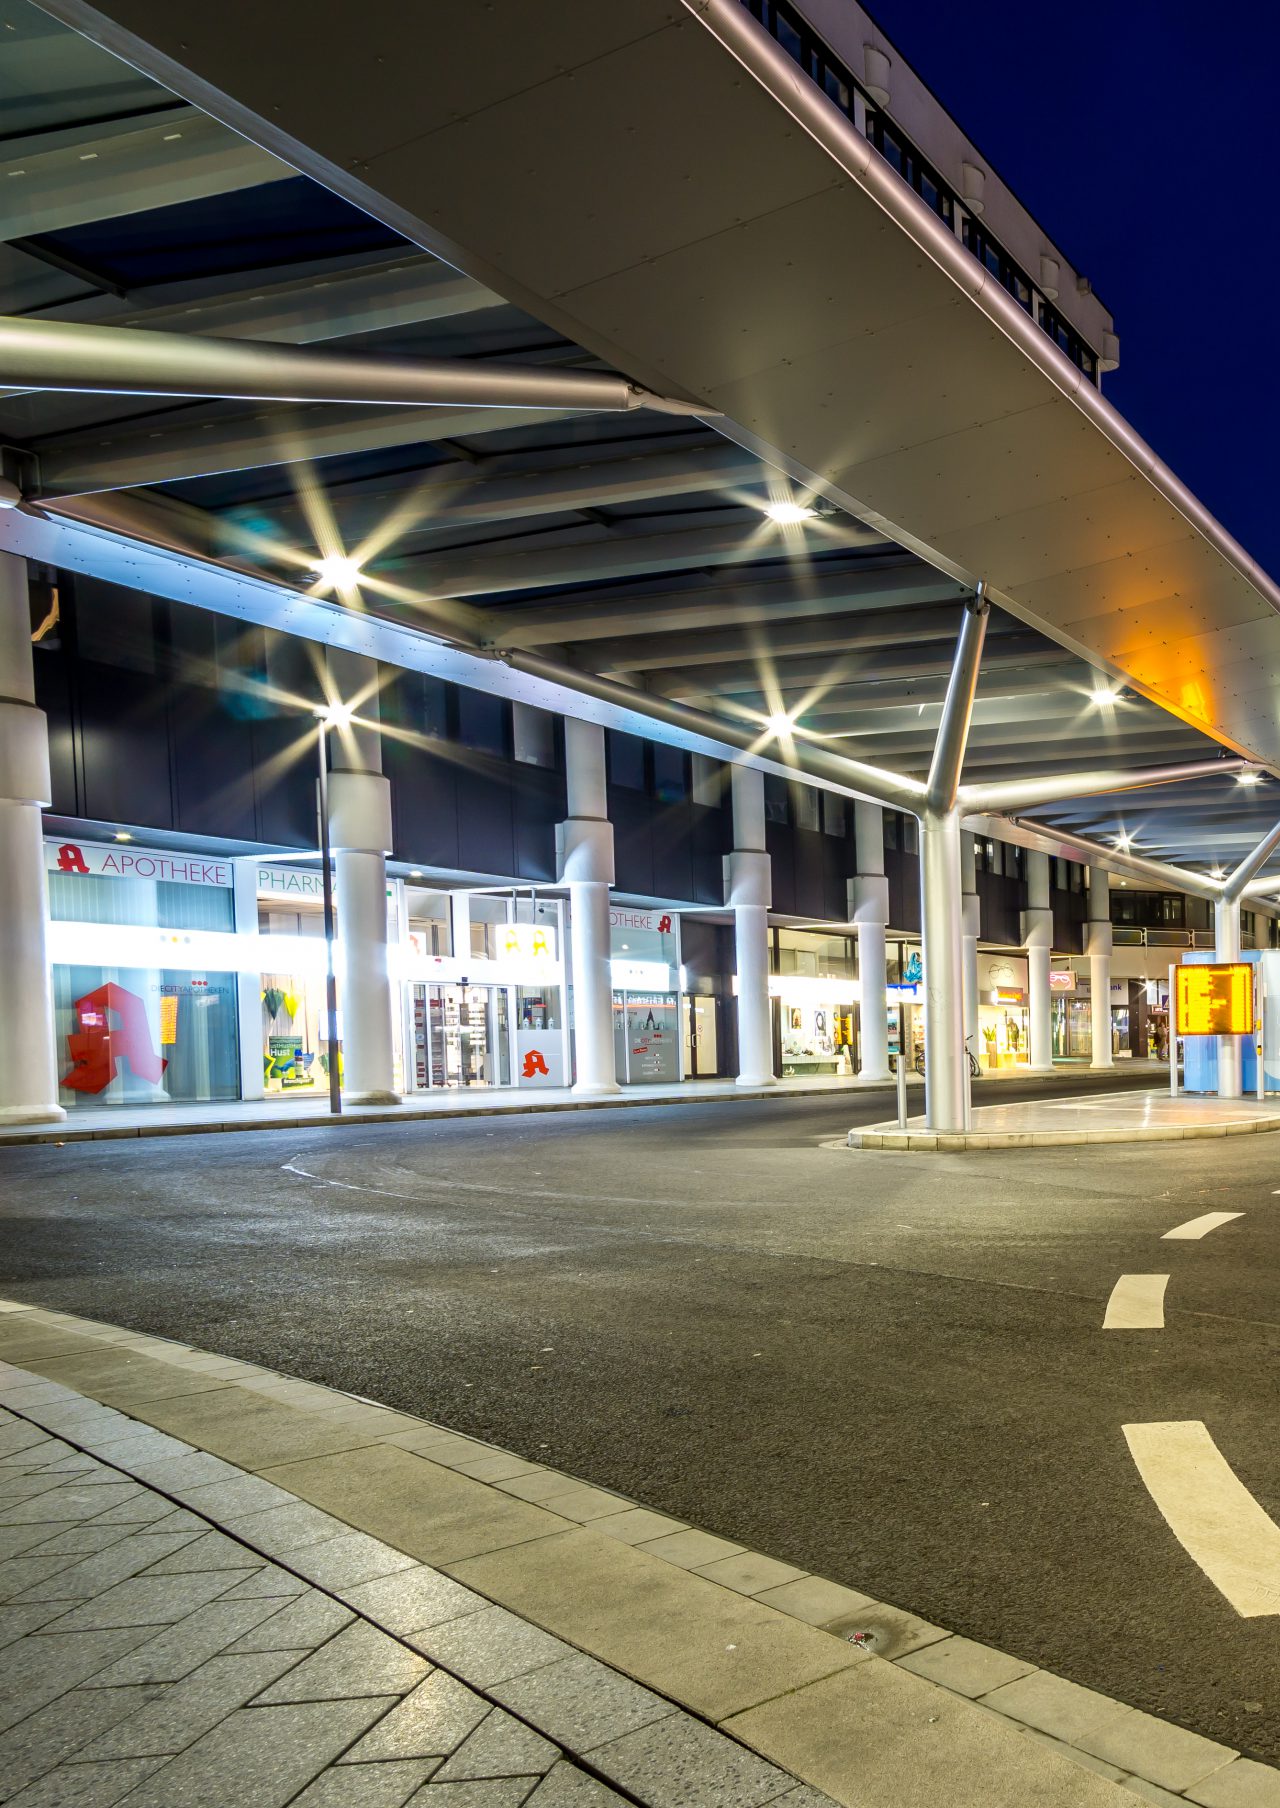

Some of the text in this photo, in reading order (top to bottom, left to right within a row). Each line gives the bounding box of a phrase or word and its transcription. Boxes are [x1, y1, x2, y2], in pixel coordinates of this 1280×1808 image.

[101, 853, 226, 885] APOTHEKE
[609, 912, 653, 929] OTHEKE
[270, 1048, 290, 1056] Hust
